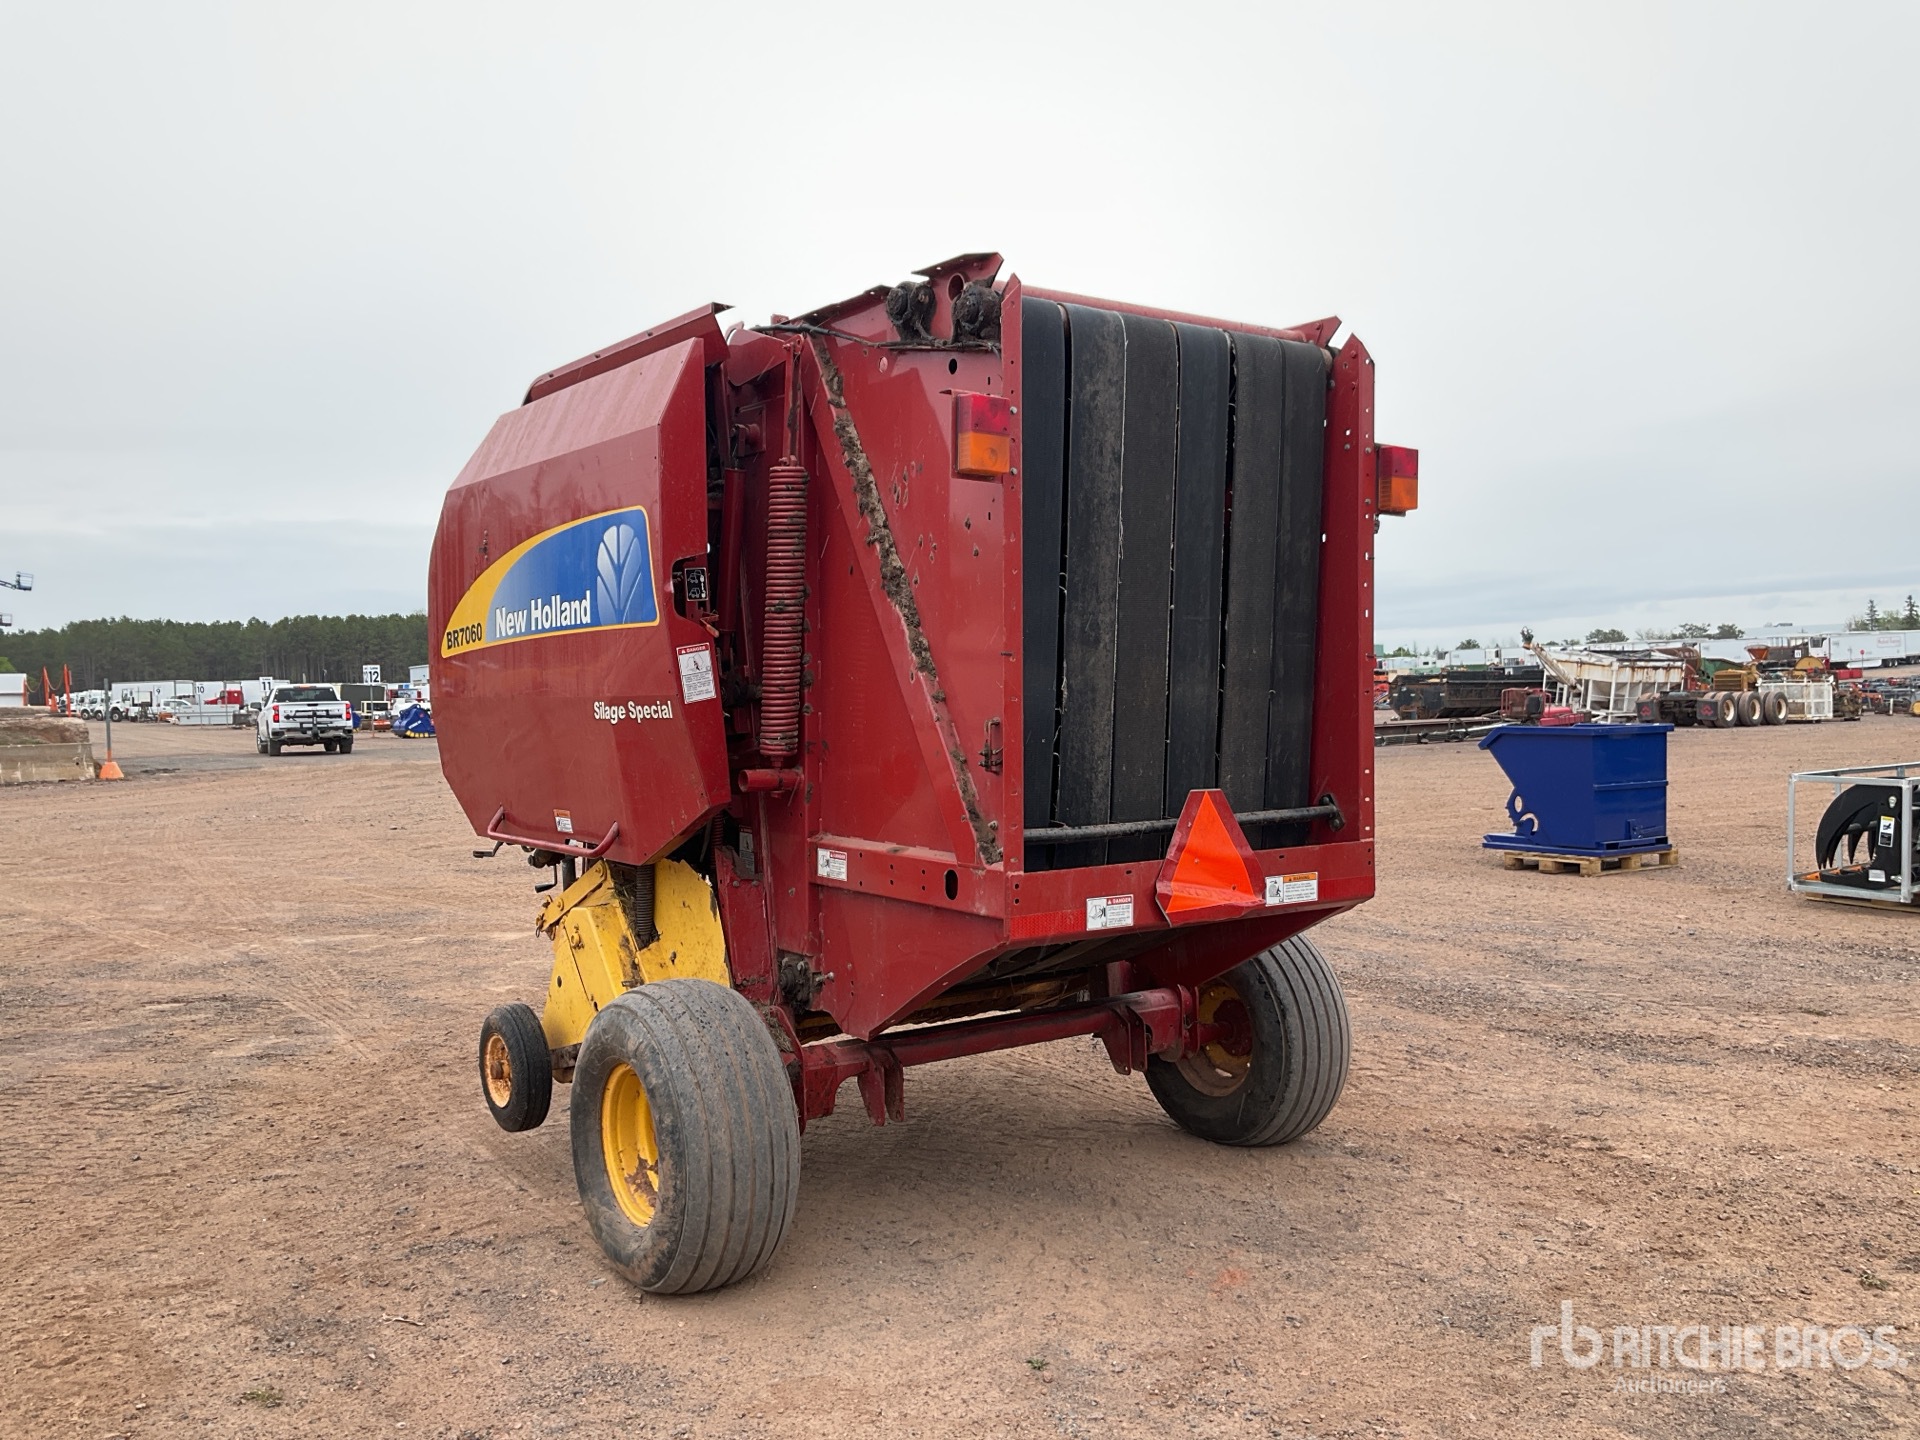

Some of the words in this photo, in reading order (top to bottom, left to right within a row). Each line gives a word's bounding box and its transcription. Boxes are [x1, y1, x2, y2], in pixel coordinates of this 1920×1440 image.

[495, 607, 527, 638] New
[530, 590, 591, 631] Holland
[446, 622, 483, 650] BR7060
[261, 681, 271, 691] 11
[368, 671, 380, 683] 12
[196, 686, 205, 694] 10
[593, 701, 626, 725] Silage
[628, 700, 673, 723] Special
